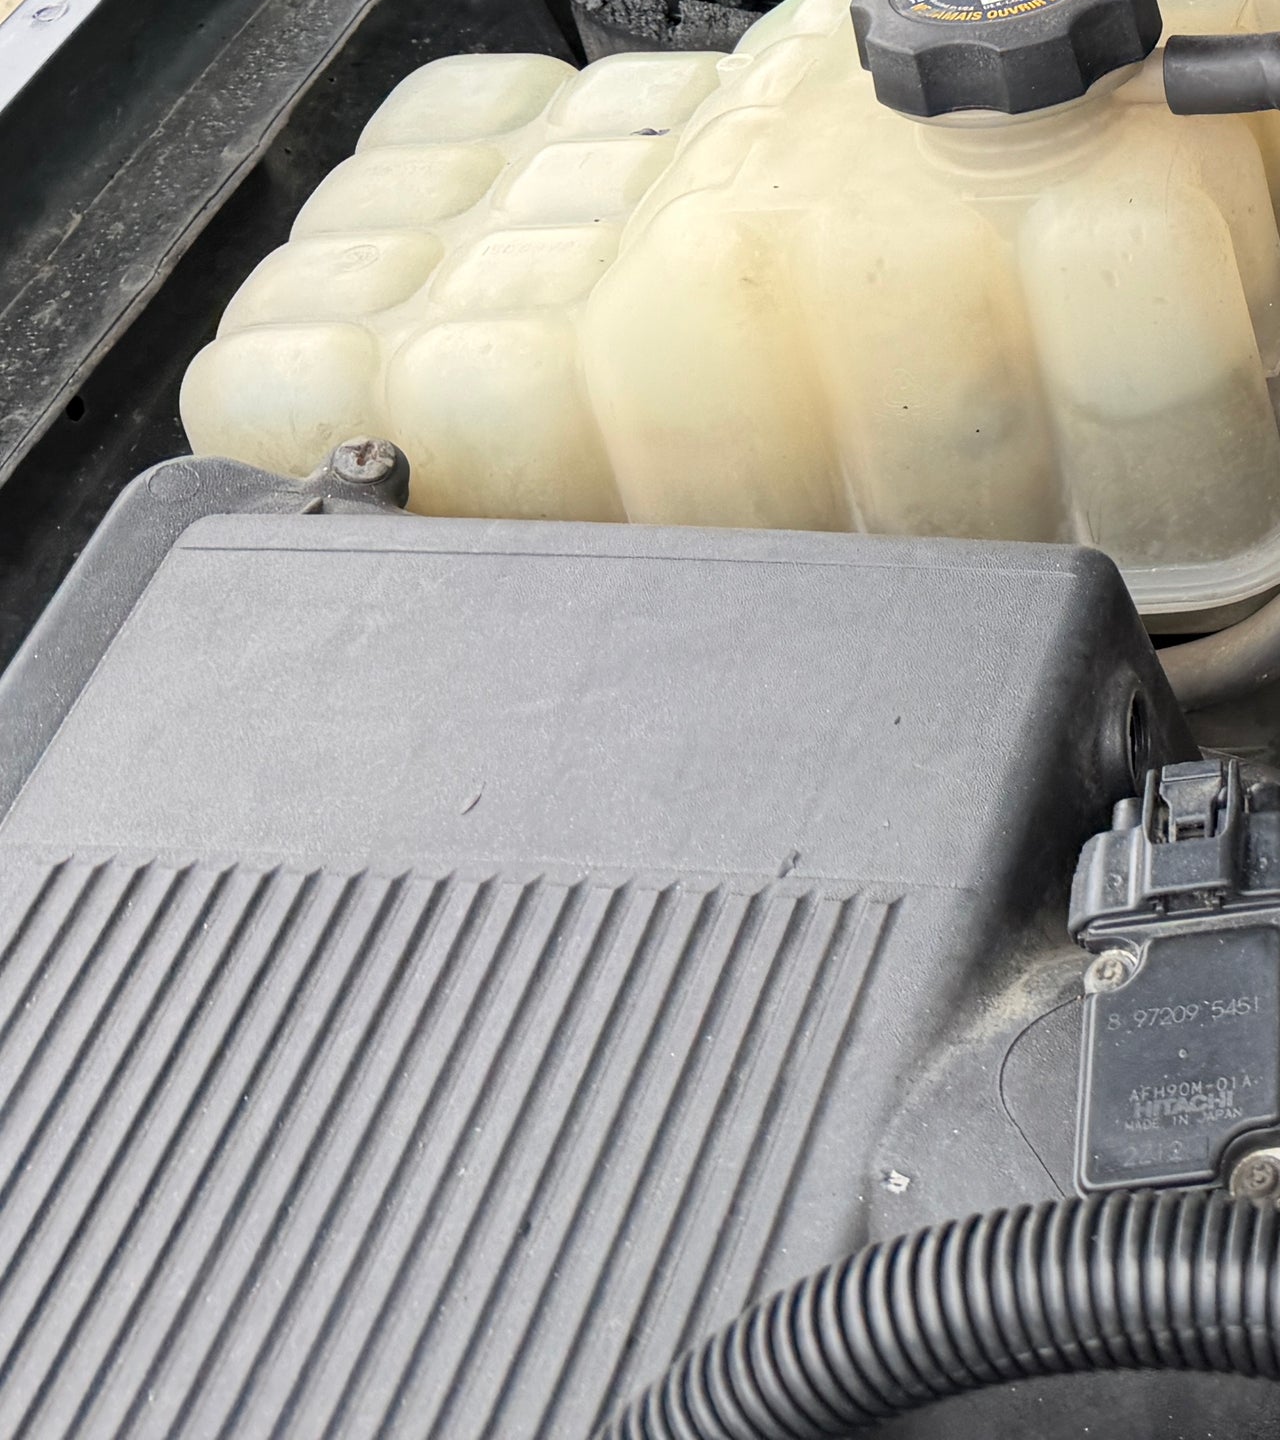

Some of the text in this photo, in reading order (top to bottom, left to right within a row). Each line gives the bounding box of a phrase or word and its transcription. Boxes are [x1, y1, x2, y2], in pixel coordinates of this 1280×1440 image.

[1133, 1003, 1199, 1028] 97209
[1211, 996, 1259, 1021] 5451
[1125, 1107, 1243, 1131] MADE IN JAPAN
[1133, 1090, 1234, 1119] HITACHI
